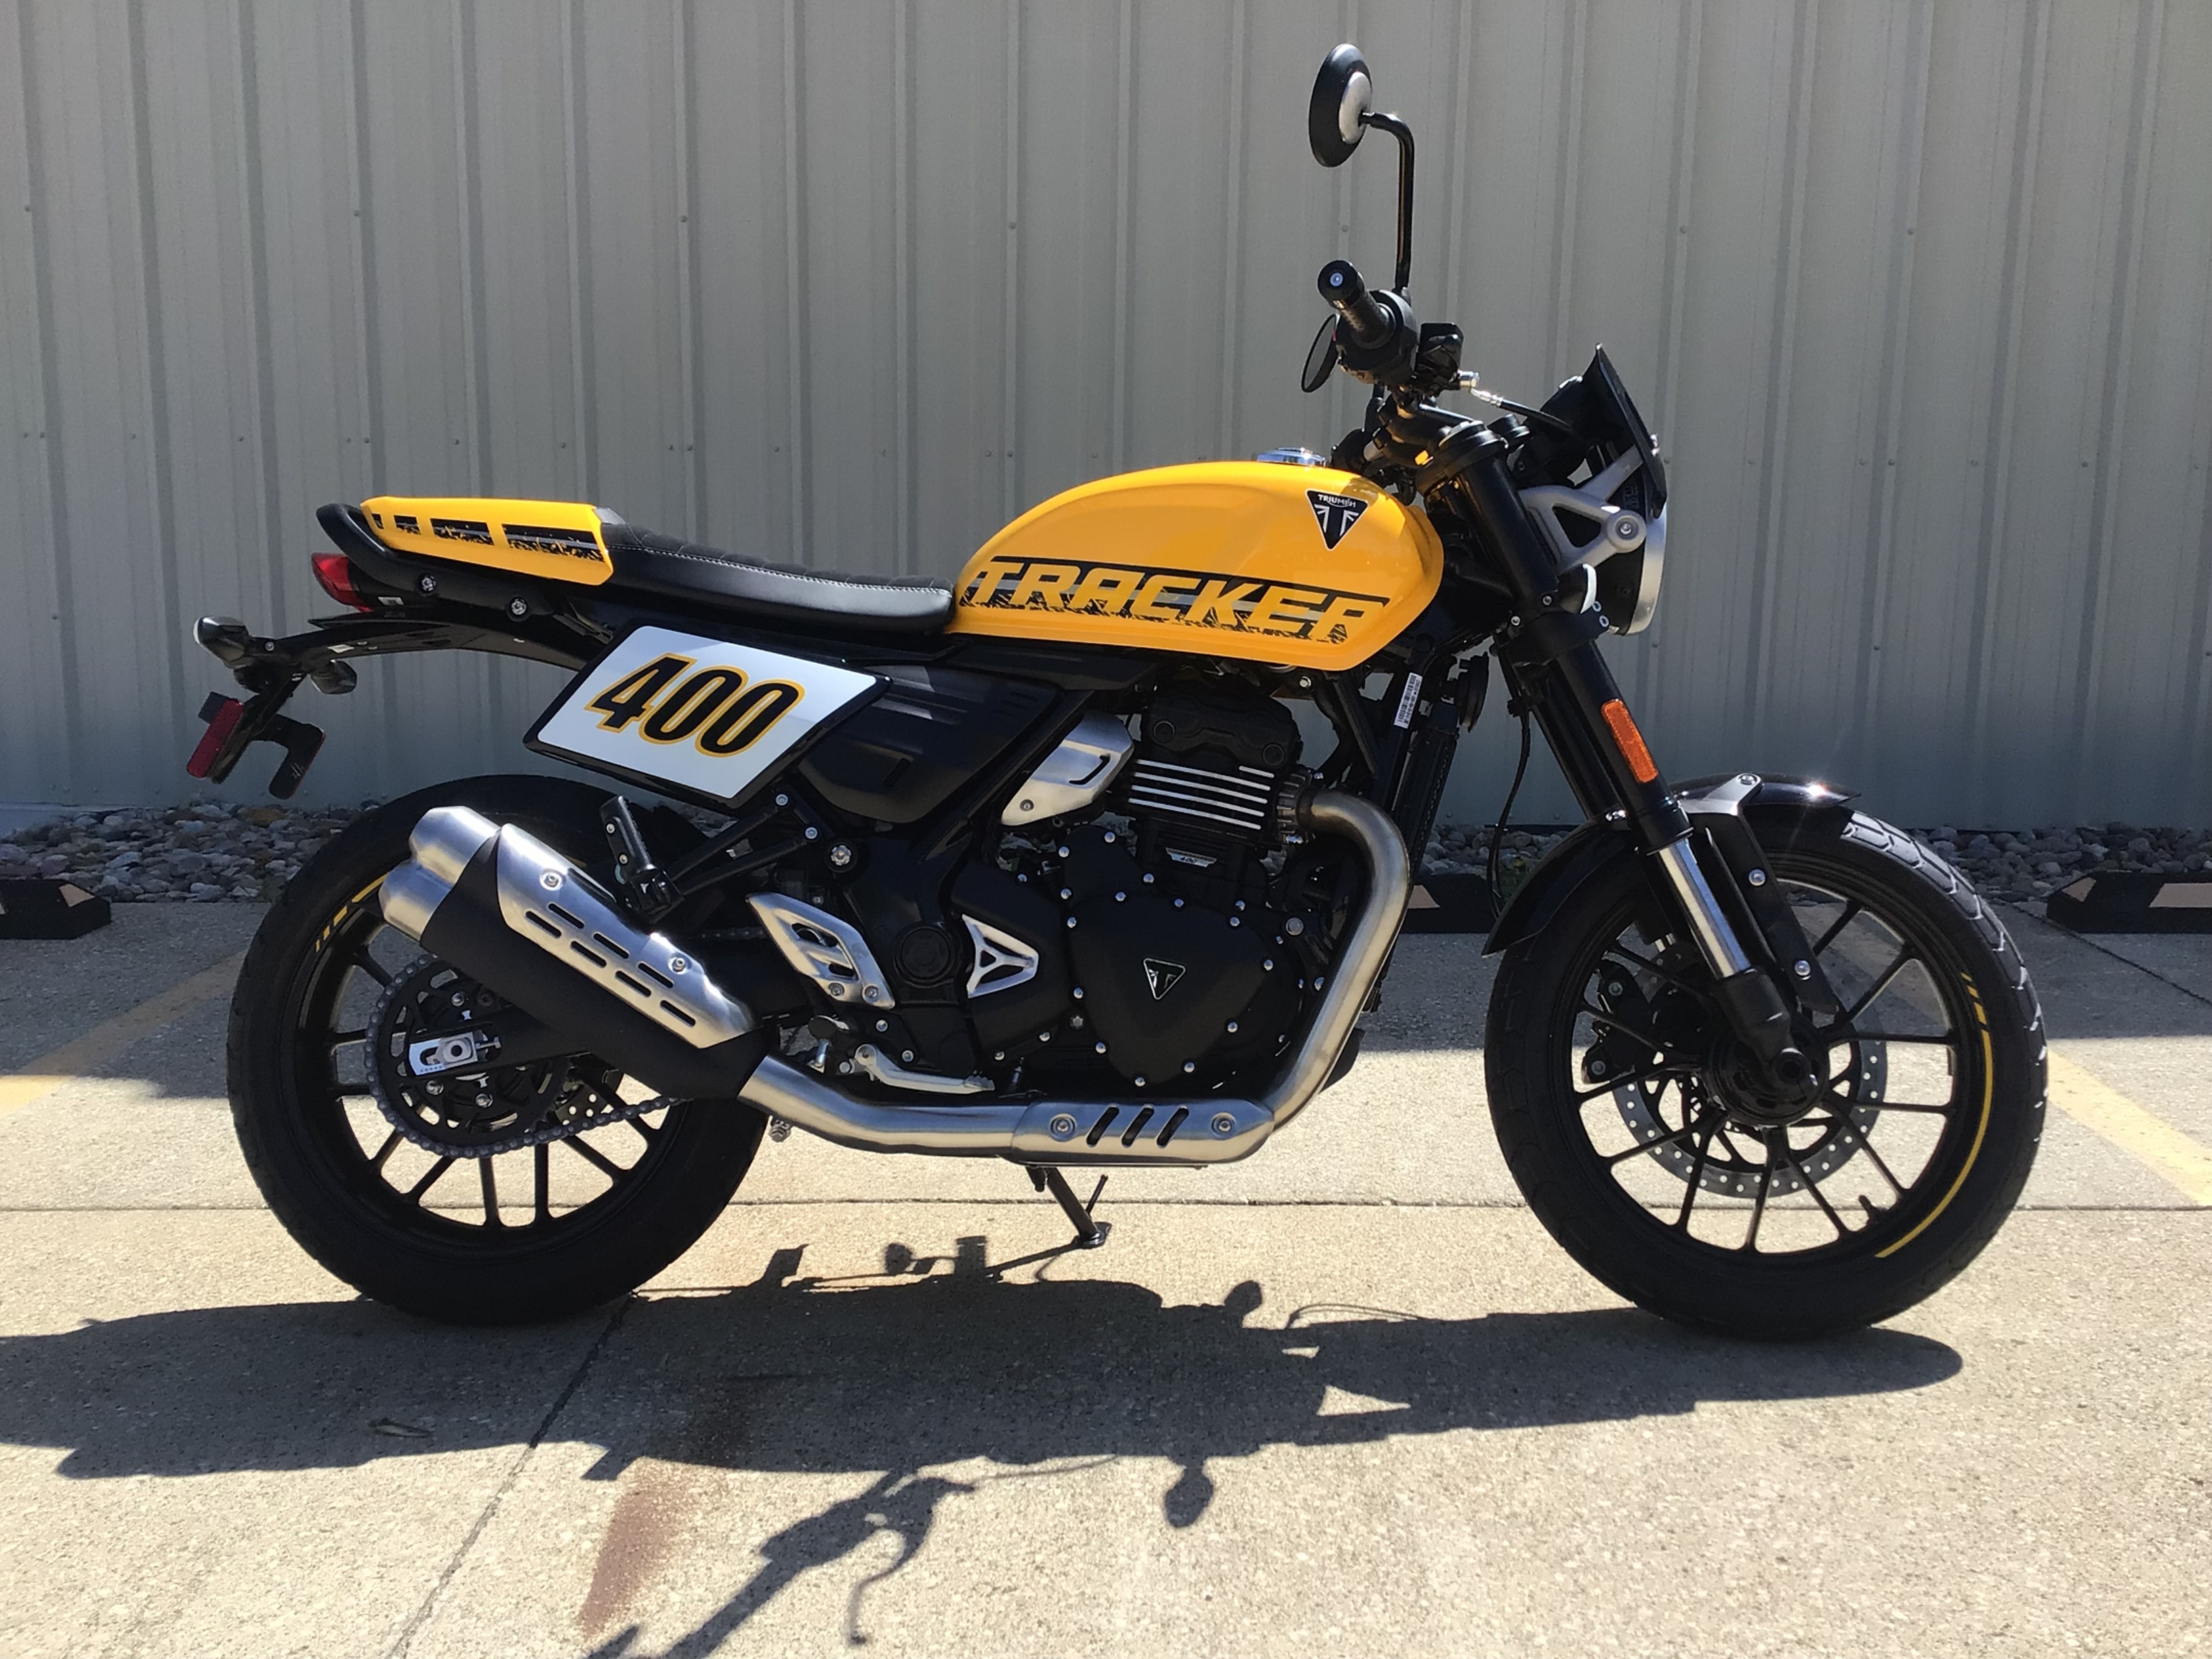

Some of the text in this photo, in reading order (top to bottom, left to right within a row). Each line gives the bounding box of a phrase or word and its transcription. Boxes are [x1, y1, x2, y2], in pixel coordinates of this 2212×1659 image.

[1317, 494, 1356, 508] TRIUMPH
[968, 560, 1385, 642] TRACKER
[584, 652, 806, 758] 400
